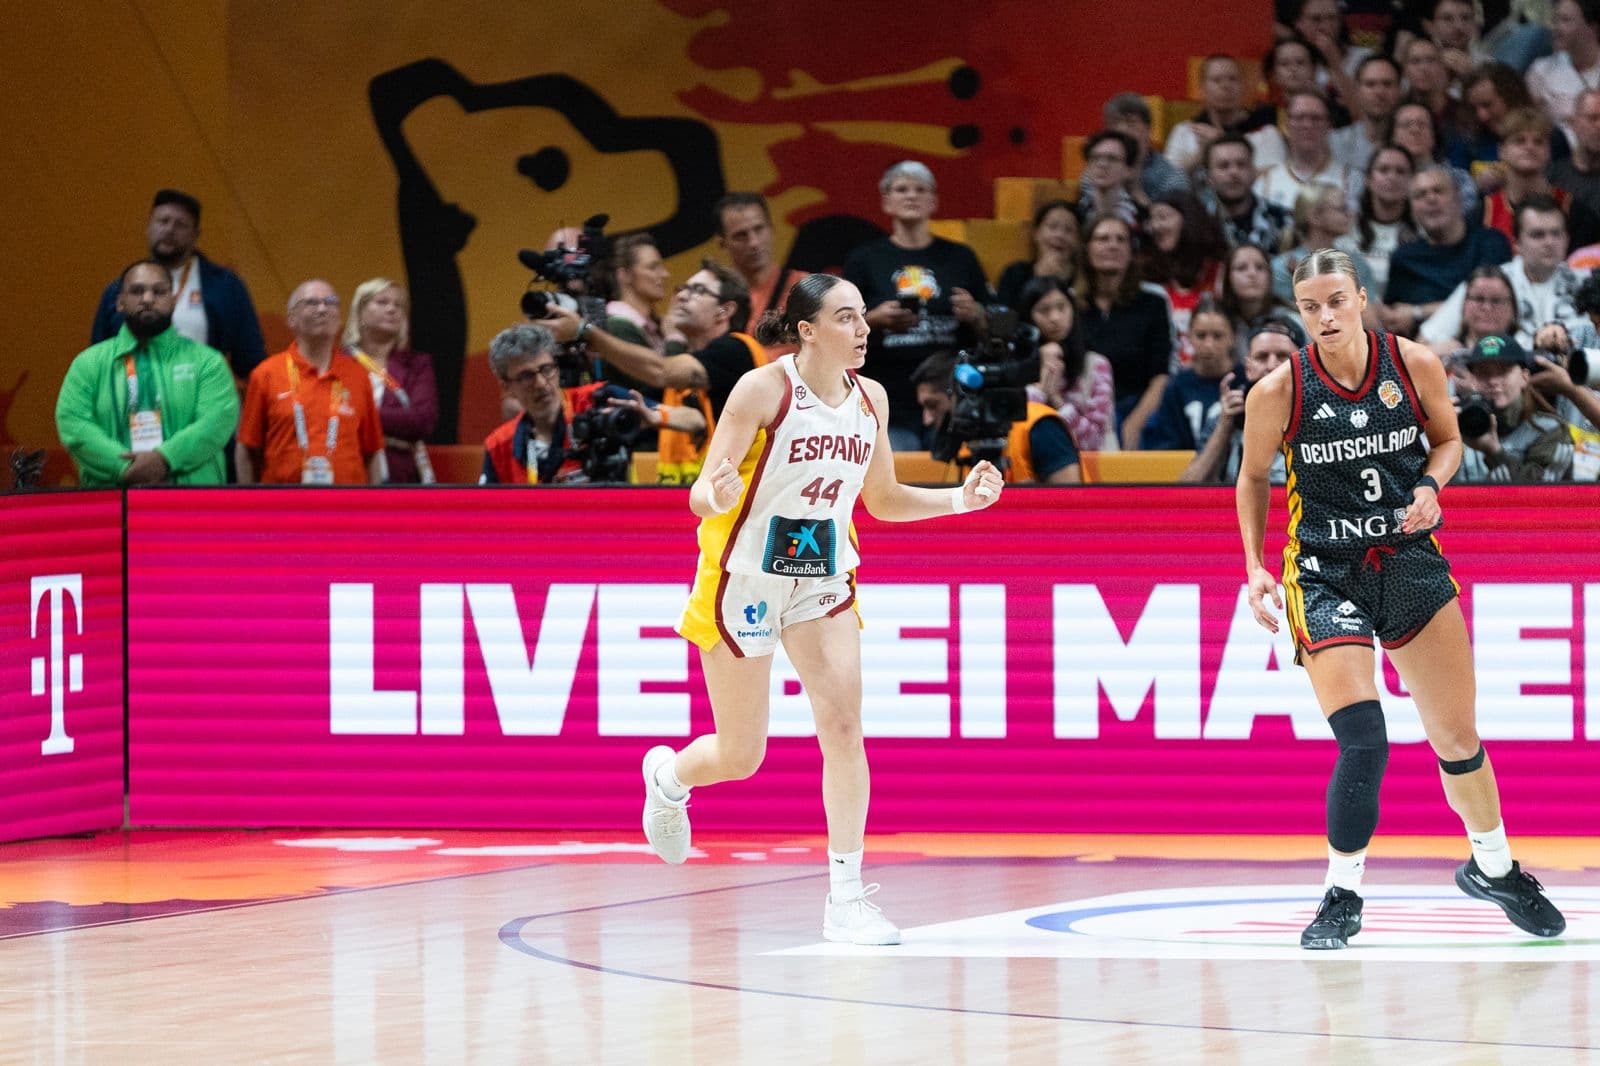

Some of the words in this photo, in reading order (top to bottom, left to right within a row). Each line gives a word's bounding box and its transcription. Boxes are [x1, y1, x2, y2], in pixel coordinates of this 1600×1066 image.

[1300, 426, 1418, 464] DEUTSCHLAND
[800, 476, 844, 508] 44
[1360, 468, 1383, 502] 3
[1327, 515, 1389, 540] ING
[772, 559, 828, 575] CaixaBank
[30, 573, 83, 756] T
[329, 582, 692, 737] LIVE
[1053, 583, 1600, 743] MAE
